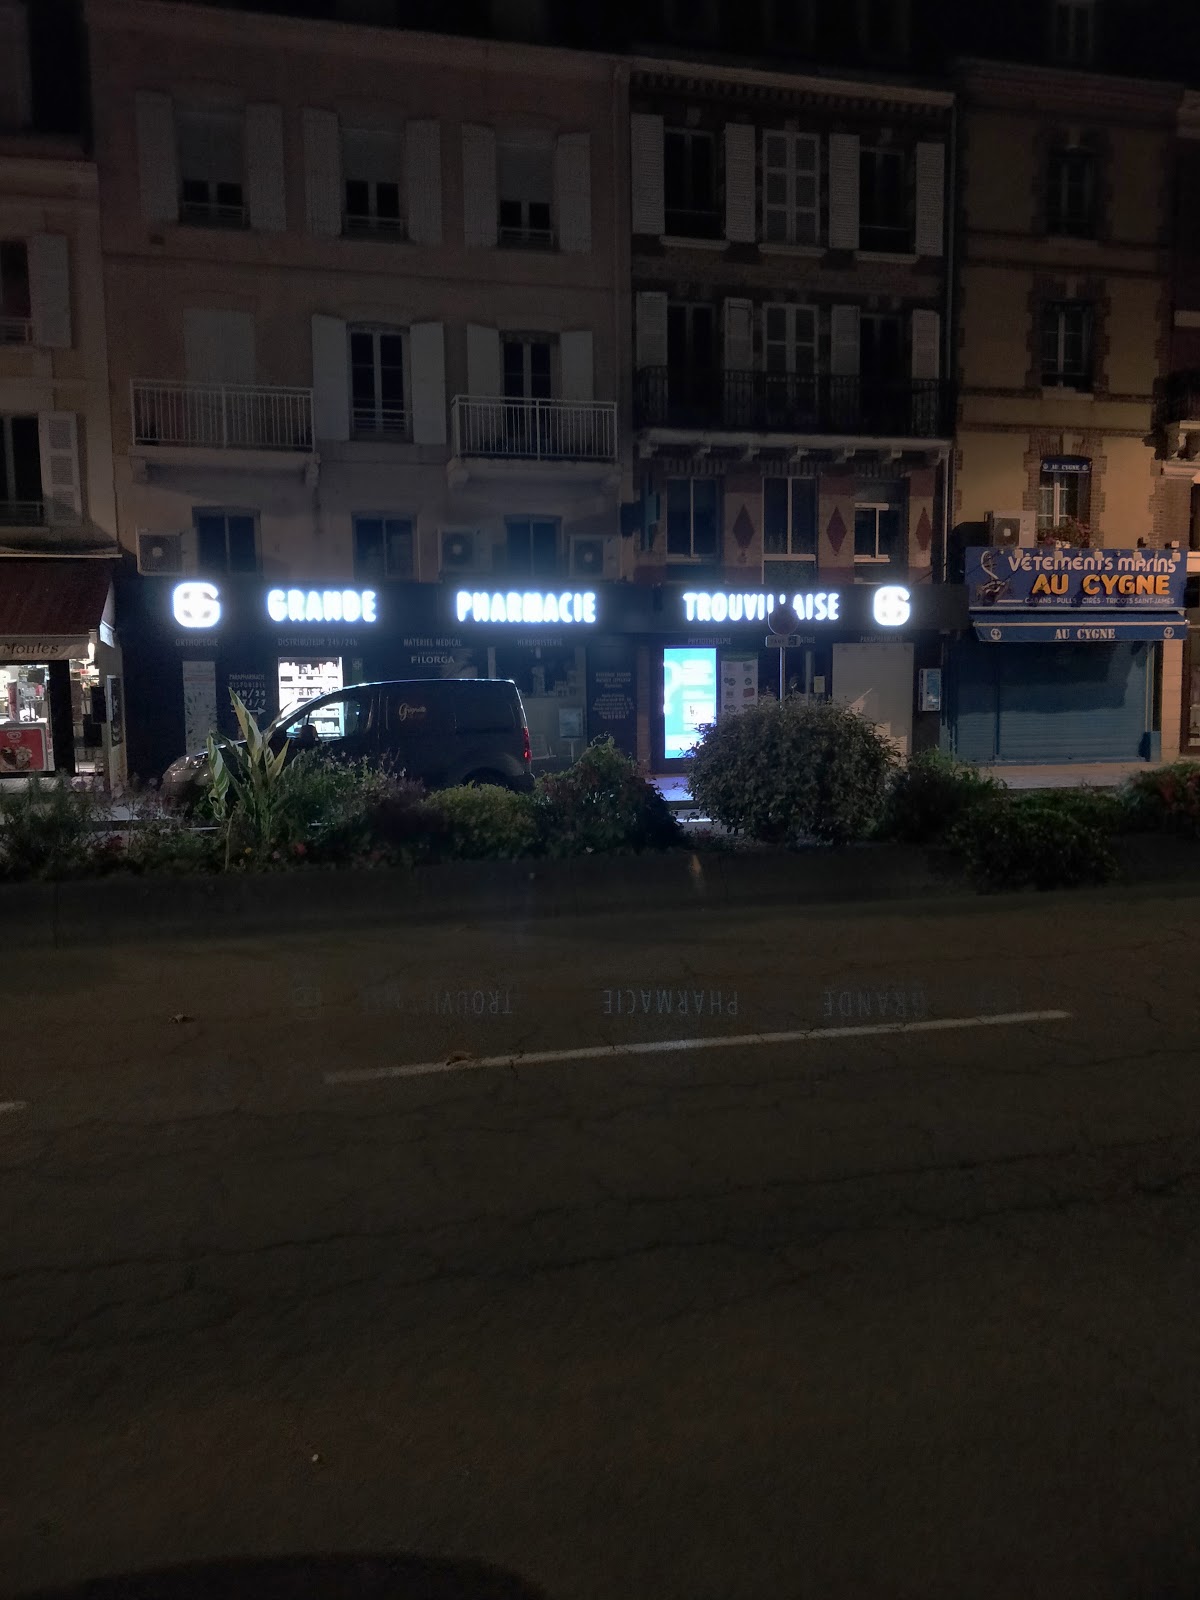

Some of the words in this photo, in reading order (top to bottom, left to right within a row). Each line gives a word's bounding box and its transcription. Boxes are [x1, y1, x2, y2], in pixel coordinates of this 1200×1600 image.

[1031, 573, 1069, 595] AU
[1082, 573, 1171, 596] CYGNE
[267, 589, 376, 622] GRANDE
[457, 591, 596, 623] PHARMACIE
[1054, 628, 1070, 640] AU
[1077, 628, 1116, 640] CYGNE
[411, 656, 455, 664] FILORGA
